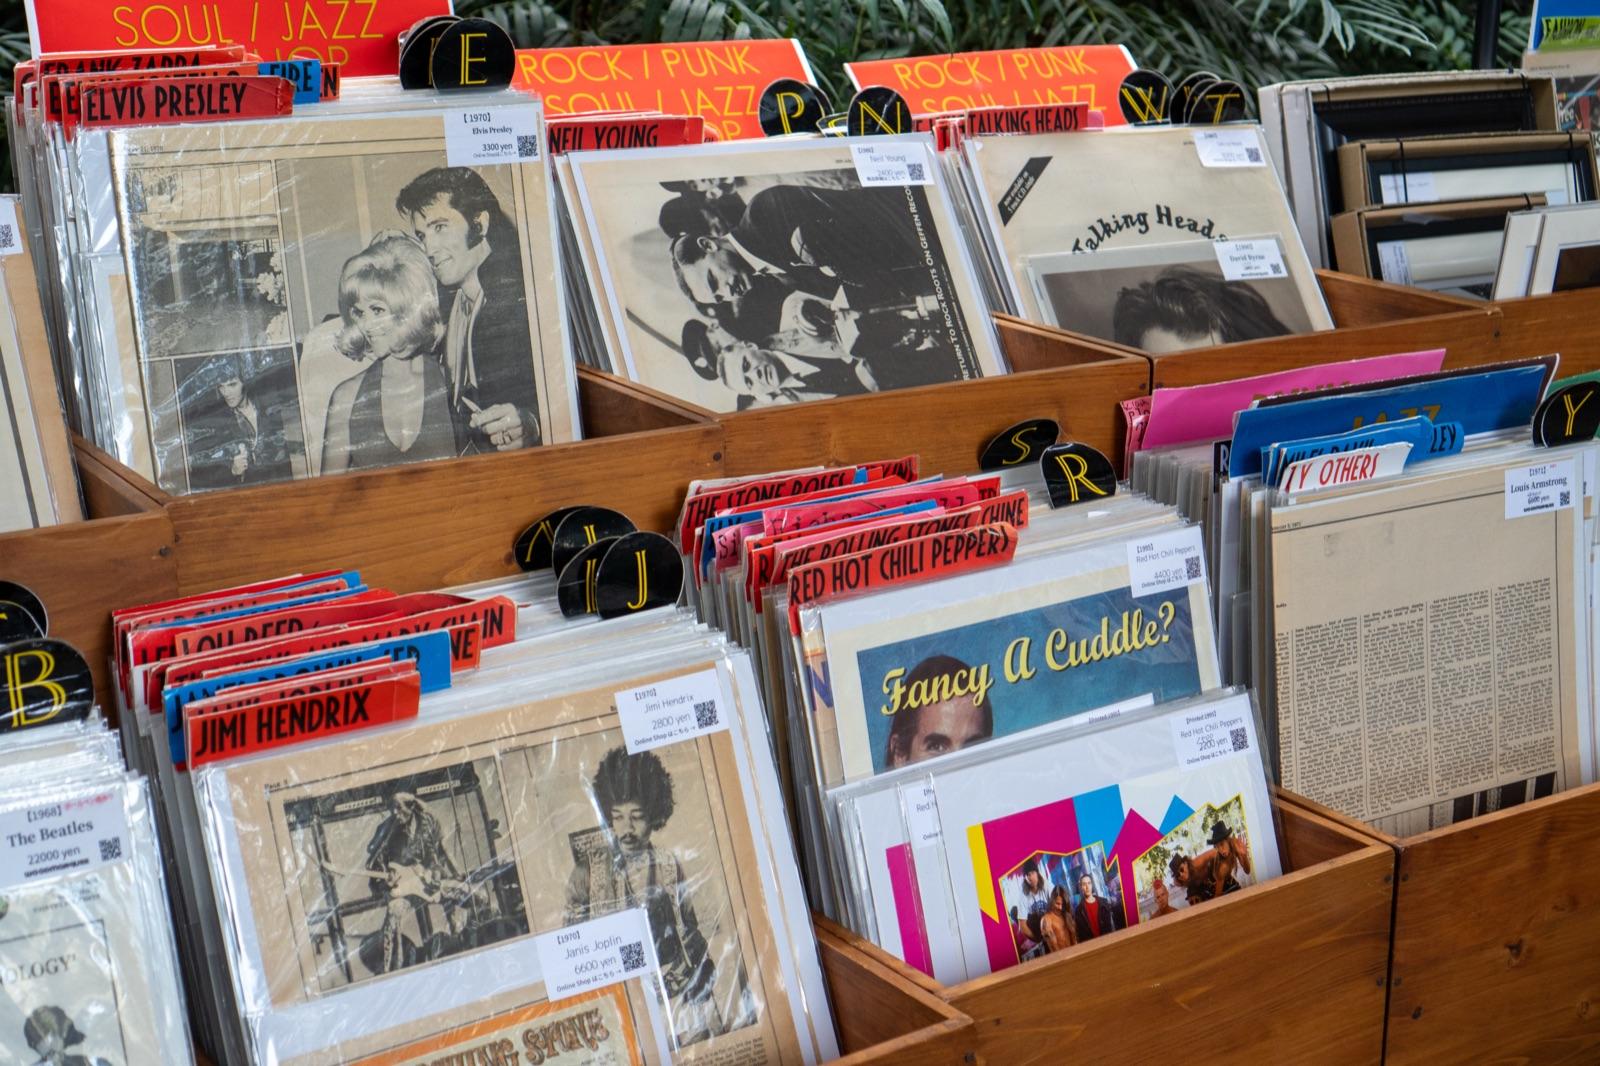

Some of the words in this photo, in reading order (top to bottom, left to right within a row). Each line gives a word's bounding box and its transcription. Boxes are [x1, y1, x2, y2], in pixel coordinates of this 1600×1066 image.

[112, 3, 234, 47] SOUL
[281, 0, 384, 41] JAZZ
[460, 33, 488, 85] E
[517, 50, 633, 84] ROCK
[661, 45, 760, 78] PUNK
[894, 57, 992, 91] ROCK
[1012, 49, 1097, 80] PUNK
[86, 85, 146, 122] ELVIS
[154, 82, 248, 118] PRESLEY
[681, 85, 759, 117] JAZZ
[776, 92, 805, 136] P
[1121, 86, 1168, 123] W
[1205, 93, 1240, 125] T
[490, 124, 513, 134] Presley
[859, 101, 901, 136] N
[969, 111, 1030, 134] TALKING
[1036, 107, 1079, 133] HEADS
[482, 143, 499, 151] 3300
[500, 143, 513, 154] yen
[550, 126, 583, 153] NEIL
[593, 123, 659, 151] YOUNG
[913, 214, 928, 249] GEFFEN
[1072, 212, 1148, 255] Talking
[1156, 204, 1229, 242] Heads
[924, 250, 934, 266] ON
[930, 268, 945, 300] ROOTS
[941, 301, 953, 327] ROCK
[949, 328, 958, 344] TO
[954, 344, 970, 381] RETURN
[1564, 390, 1594, 436] Y
[1002, 427, 1038, 465] S
[1055, 453, 1108, 502] R
[1319, 453, 1379, 486] OTHERS
[1511, 484, 1530, 494] Louis
[1531, 477, 1567, 490] Armstrong
[981, 497, 1025, 530] CHINE
[626, 550, 648, 610] J
[790, 568, 826, 604] RED
[832, 554, 873, 594] HOT
[879, 541, 925, 581] CHILI
[931, 524, 1010, 569] PEPPERS
[881, 656, 993, 716] Fancy
[1004, 637, 1036, 684] A
[1045, 601, 1175, 672] Cuddle?
[3, 649, 67, 728] B
[644, 703, 661, 713] Jimi
[662, 694, 695, 708] Hendrix
[195, 712, 247, 758] JIMI
[257, 687, 371, 744] HENDRIX
[652, 715, 674, 730] 2800
[675, 713, 691, 725] yen
[1219, 717, 1243, 729] Peppers
[634, 737, 652, 746] Online
[653, 733, 667, 741] Shop
[1217, 737, 1228, 747] yen
[7, 833, 36, 848] The
[39, 820, 94, 841] Beatles
[27, 849, 59, 866] 22000
[61, 846, 81, 860] yen
[557, 931, 580, 945] 【1970】
[565, 944, 590, 960] Janis
[592, 935, 623, 953] Joplin
[574, 960, 599, 974] 6600
[600, 956, 617, 969] yen
[557, 983, 576, 993] Online
[576, 978, 591, 988] Shop
